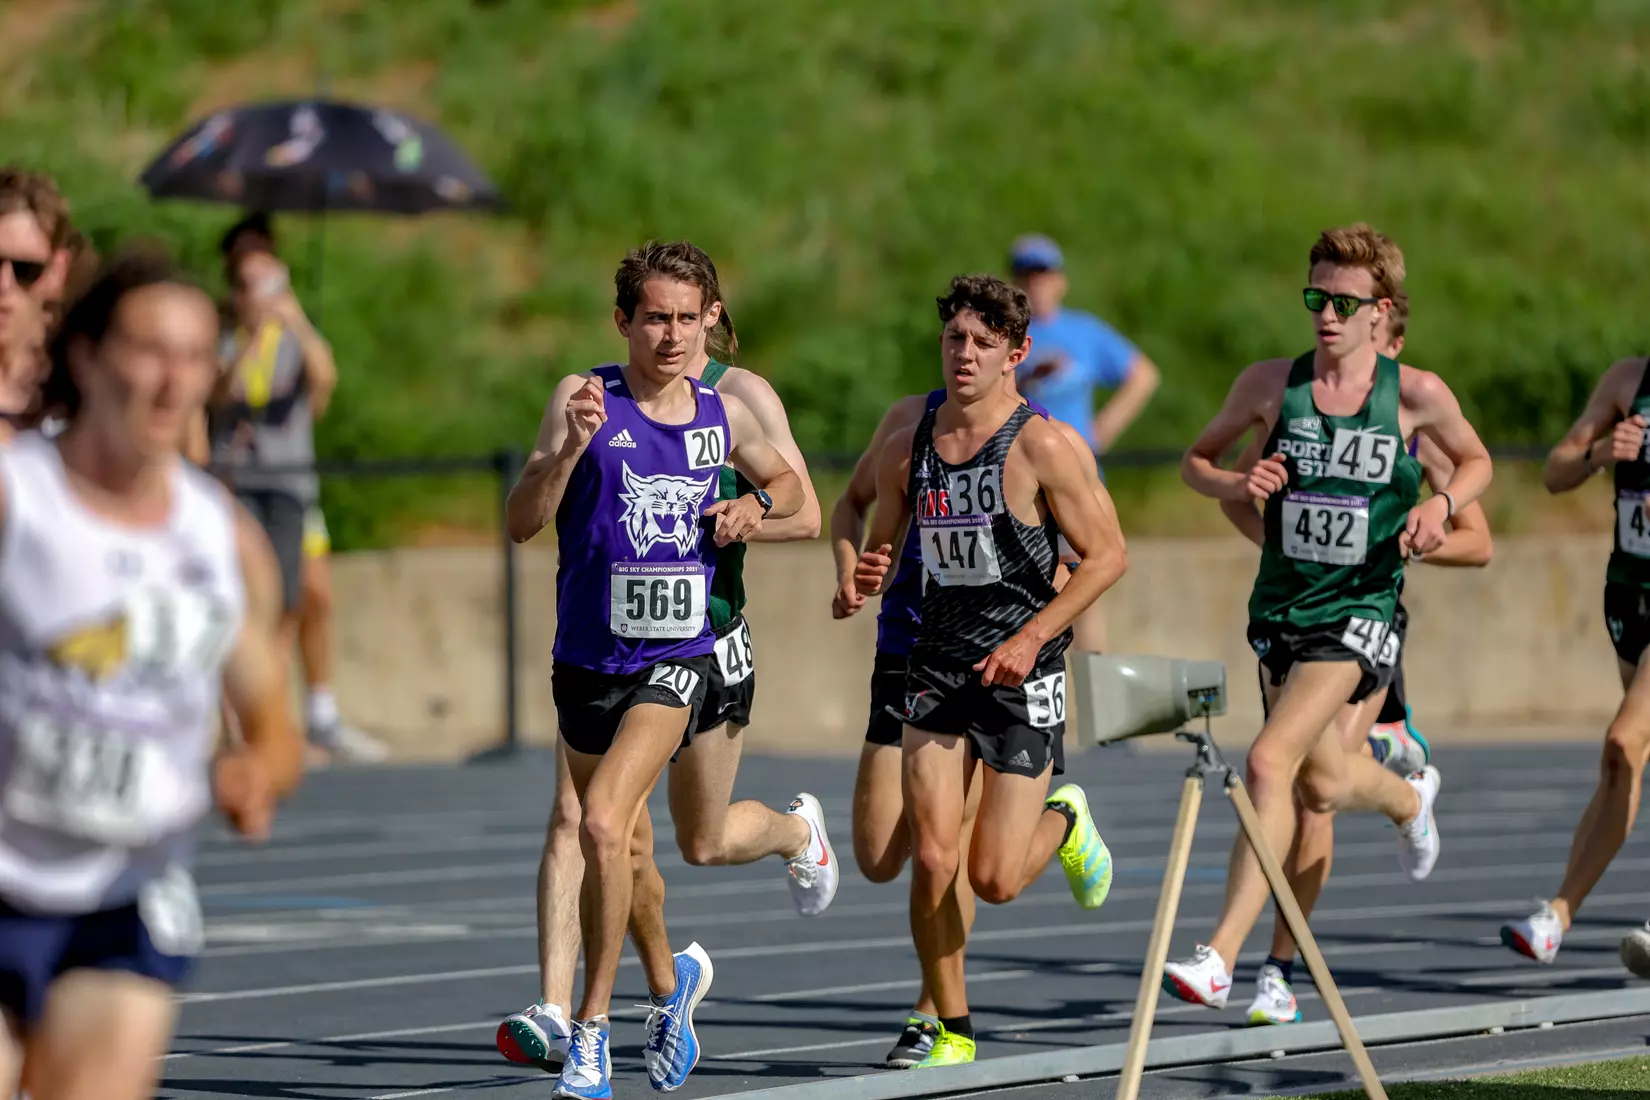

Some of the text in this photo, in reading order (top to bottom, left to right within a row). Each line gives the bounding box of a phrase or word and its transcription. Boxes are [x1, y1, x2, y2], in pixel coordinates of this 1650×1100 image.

[608, 440, 637, 449] adidas
[692, 429, 721, 467] 20
[1337, 436, 1391, 479] 45
[957, 469, 996, 515] 36
[1295, 507, 1355, 547] 432
[931, 530, 978, 569] 147
[626, 578, 692, 621] 569
[726, 625, 753, 679] 48
[656, 663, 692, 695] 20
